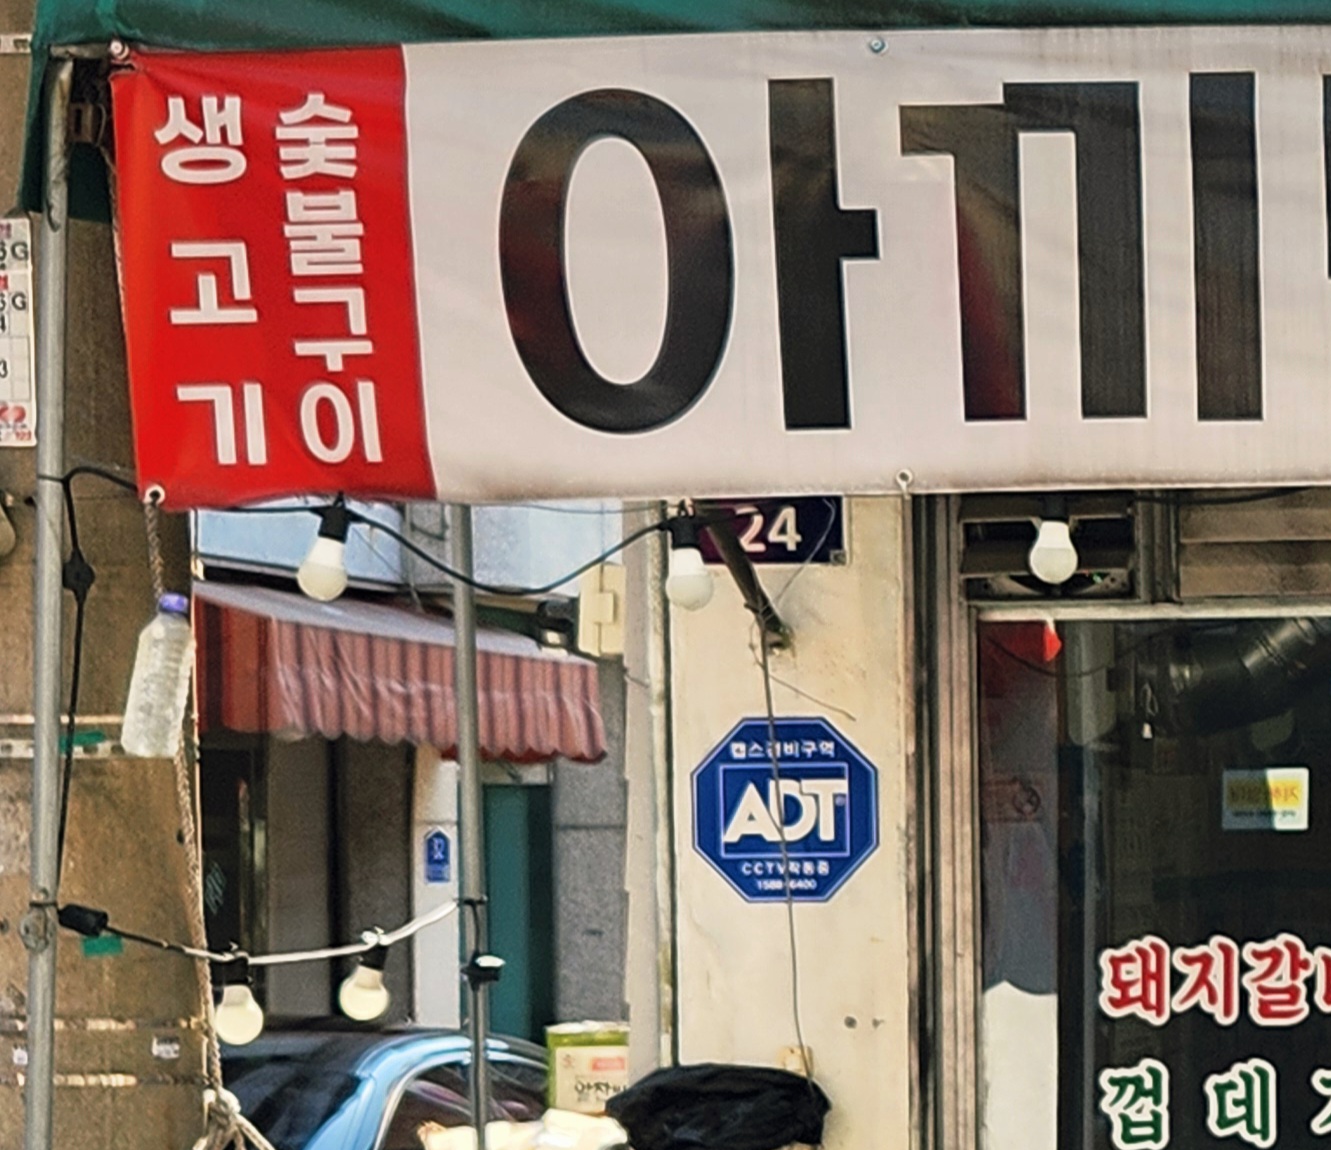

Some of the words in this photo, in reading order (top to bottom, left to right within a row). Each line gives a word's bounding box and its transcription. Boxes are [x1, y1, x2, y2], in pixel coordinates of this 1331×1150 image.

[153, 94, 270, 467] 생고기
[275, 92, 384, 464] 숯불구이
[723, 778, 849, 843] ADT
